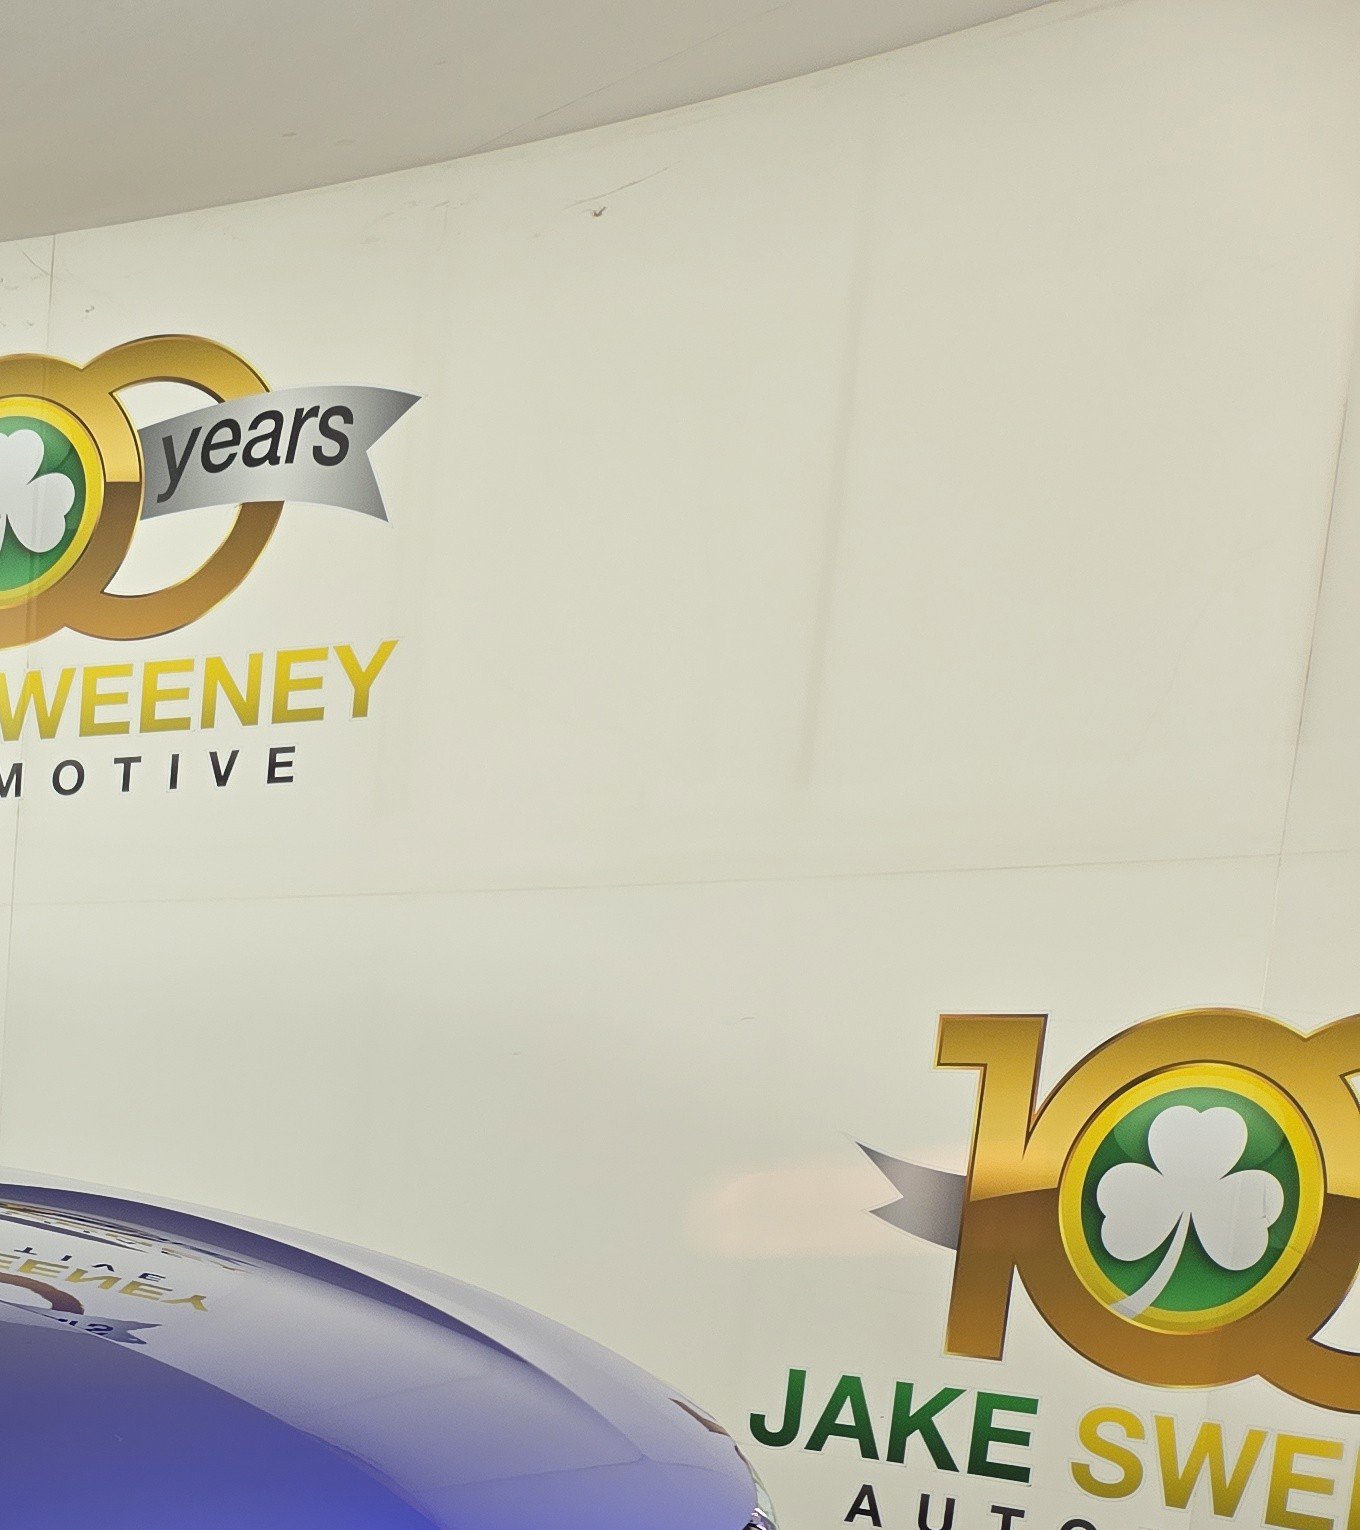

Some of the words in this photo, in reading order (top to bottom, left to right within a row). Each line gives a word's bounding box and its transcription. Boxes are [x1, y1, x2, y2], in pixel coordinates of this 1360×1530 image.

[157, 404, 354, 503] years
[934, 1006, 1360, 1415] 10
[749, 1368, 1039, 1484] JAKE
